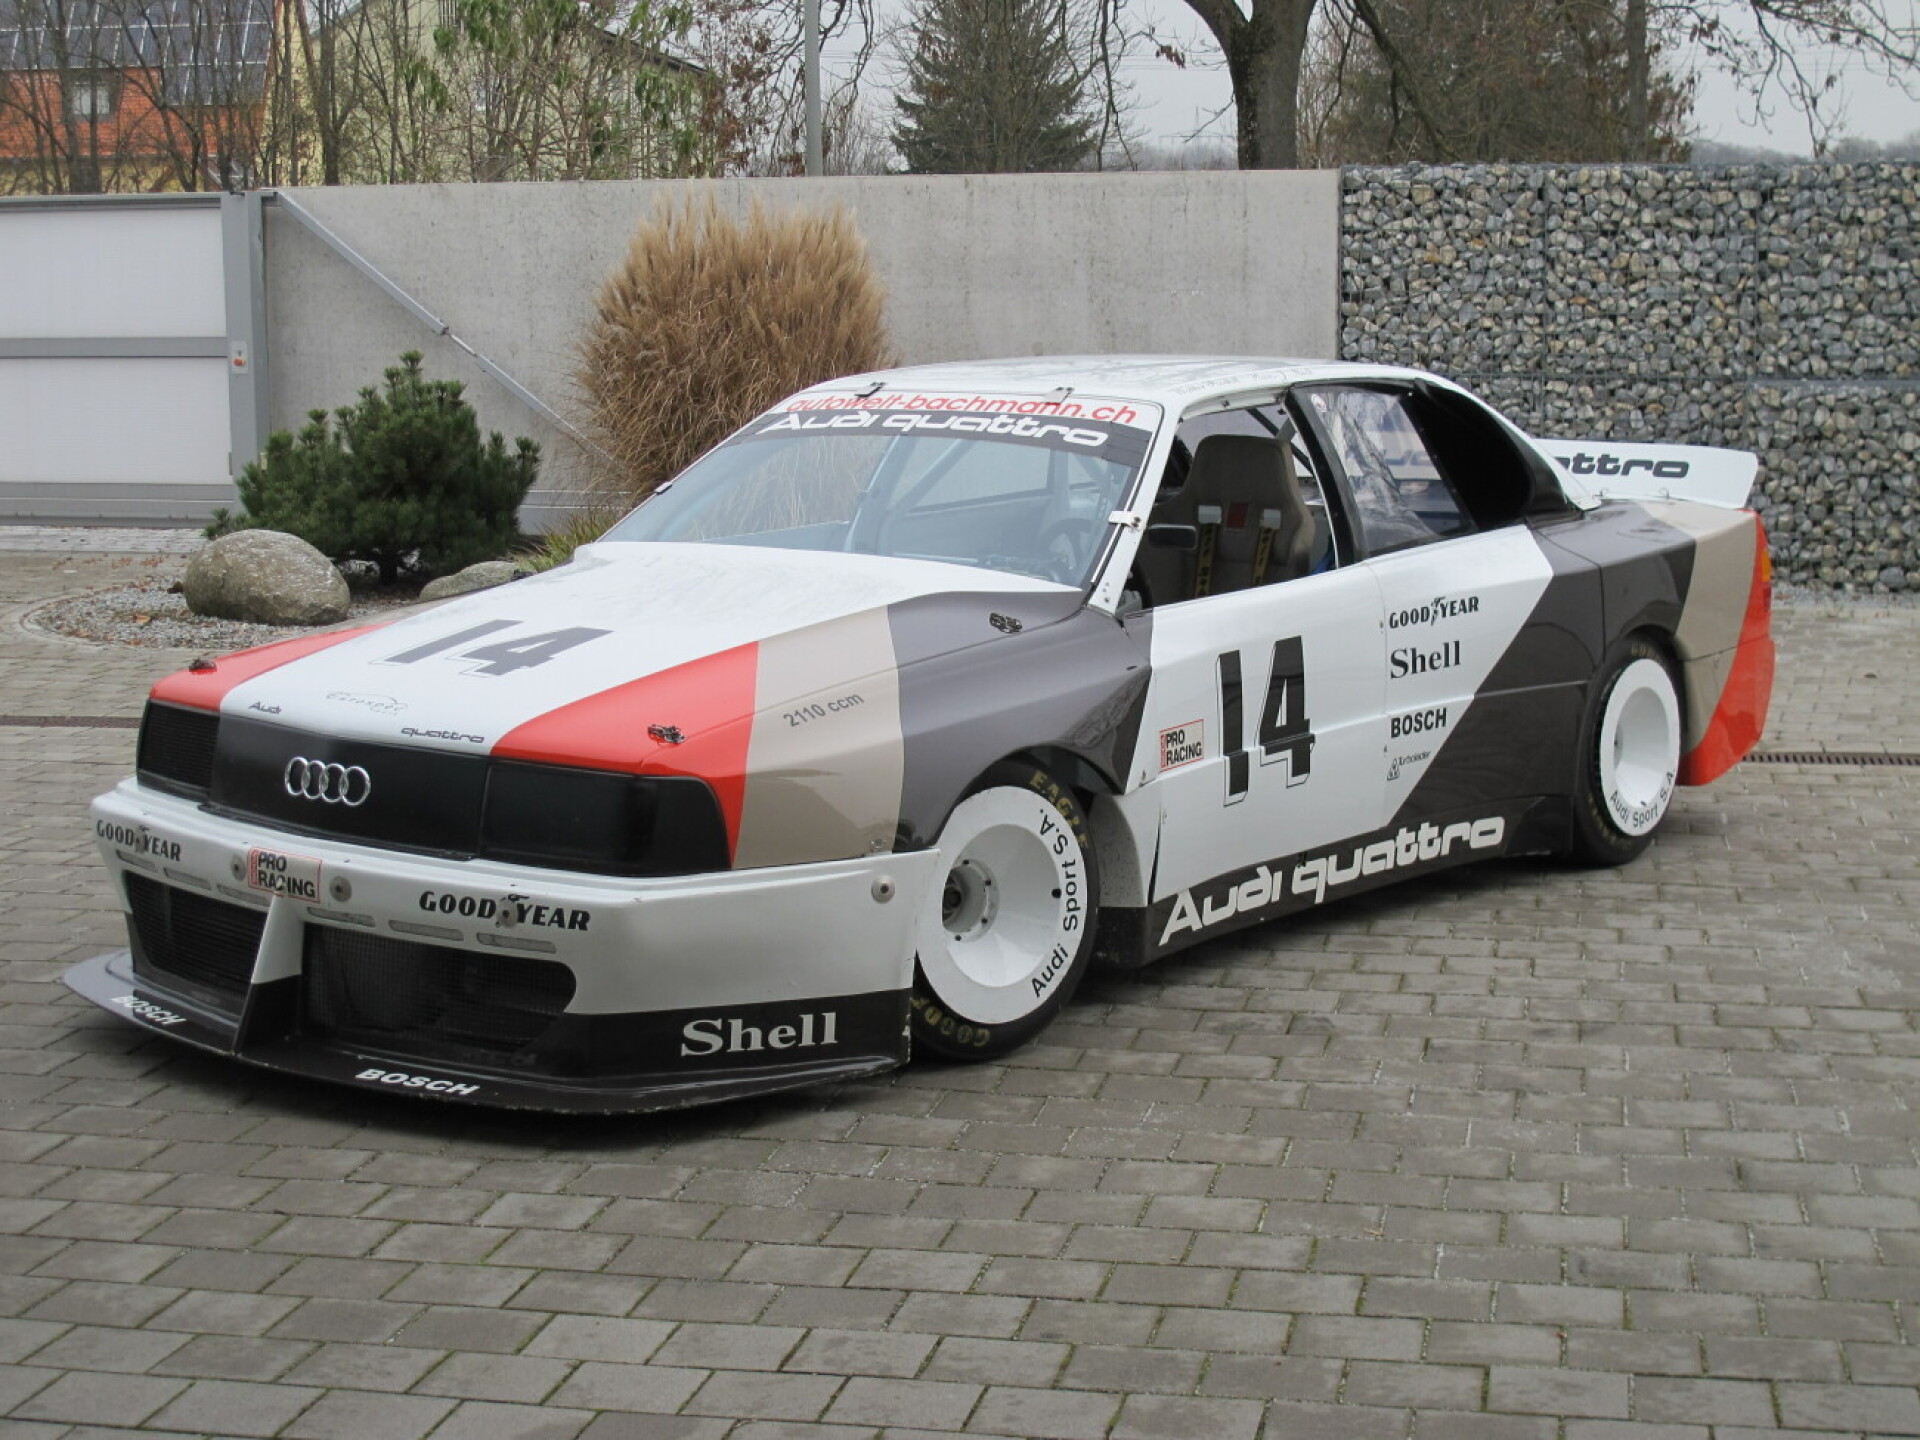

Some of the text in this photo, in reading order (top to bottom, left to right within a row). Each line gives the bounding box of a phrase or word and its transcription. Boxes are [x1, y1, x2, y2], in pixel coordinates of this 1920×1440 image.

[786, 394, 1137, 424] autowelt-bachmann.ch
[758, 410, 1109, 447] Audi quattro
[374, 618, 615, 677] 14
[1389, 640, 1461, 679] Shell
[248, 701, 282, 715] Audi
[782, 694, 865, 727] 2110 ccm
[1216, 635, 1316, 804] 14
[1390, 707, 1447, 738] BOSCH
[400, 727, 485, 744] quattro
[1166, 729, 1186, 748] PRO
[1166, 741, 1202, 766] RACING
[1609, 789, 1629, 824] Audi
[1632, 803, 1658, 828] Sport
[257, 850, 288, 873] PRO
[257, 870, 317, 899] RACING
[1158, 866, 1282, 946] Audi
[1292, 816, 1505, 904] quattro
[1031, 808, 1081, 997] Audi Sport S.A.
[110, 995, 187, 1025] BOSCH
[680, 1011, 839, 1057] Shell
[355, 1068, 481, 1095] BOSCH
